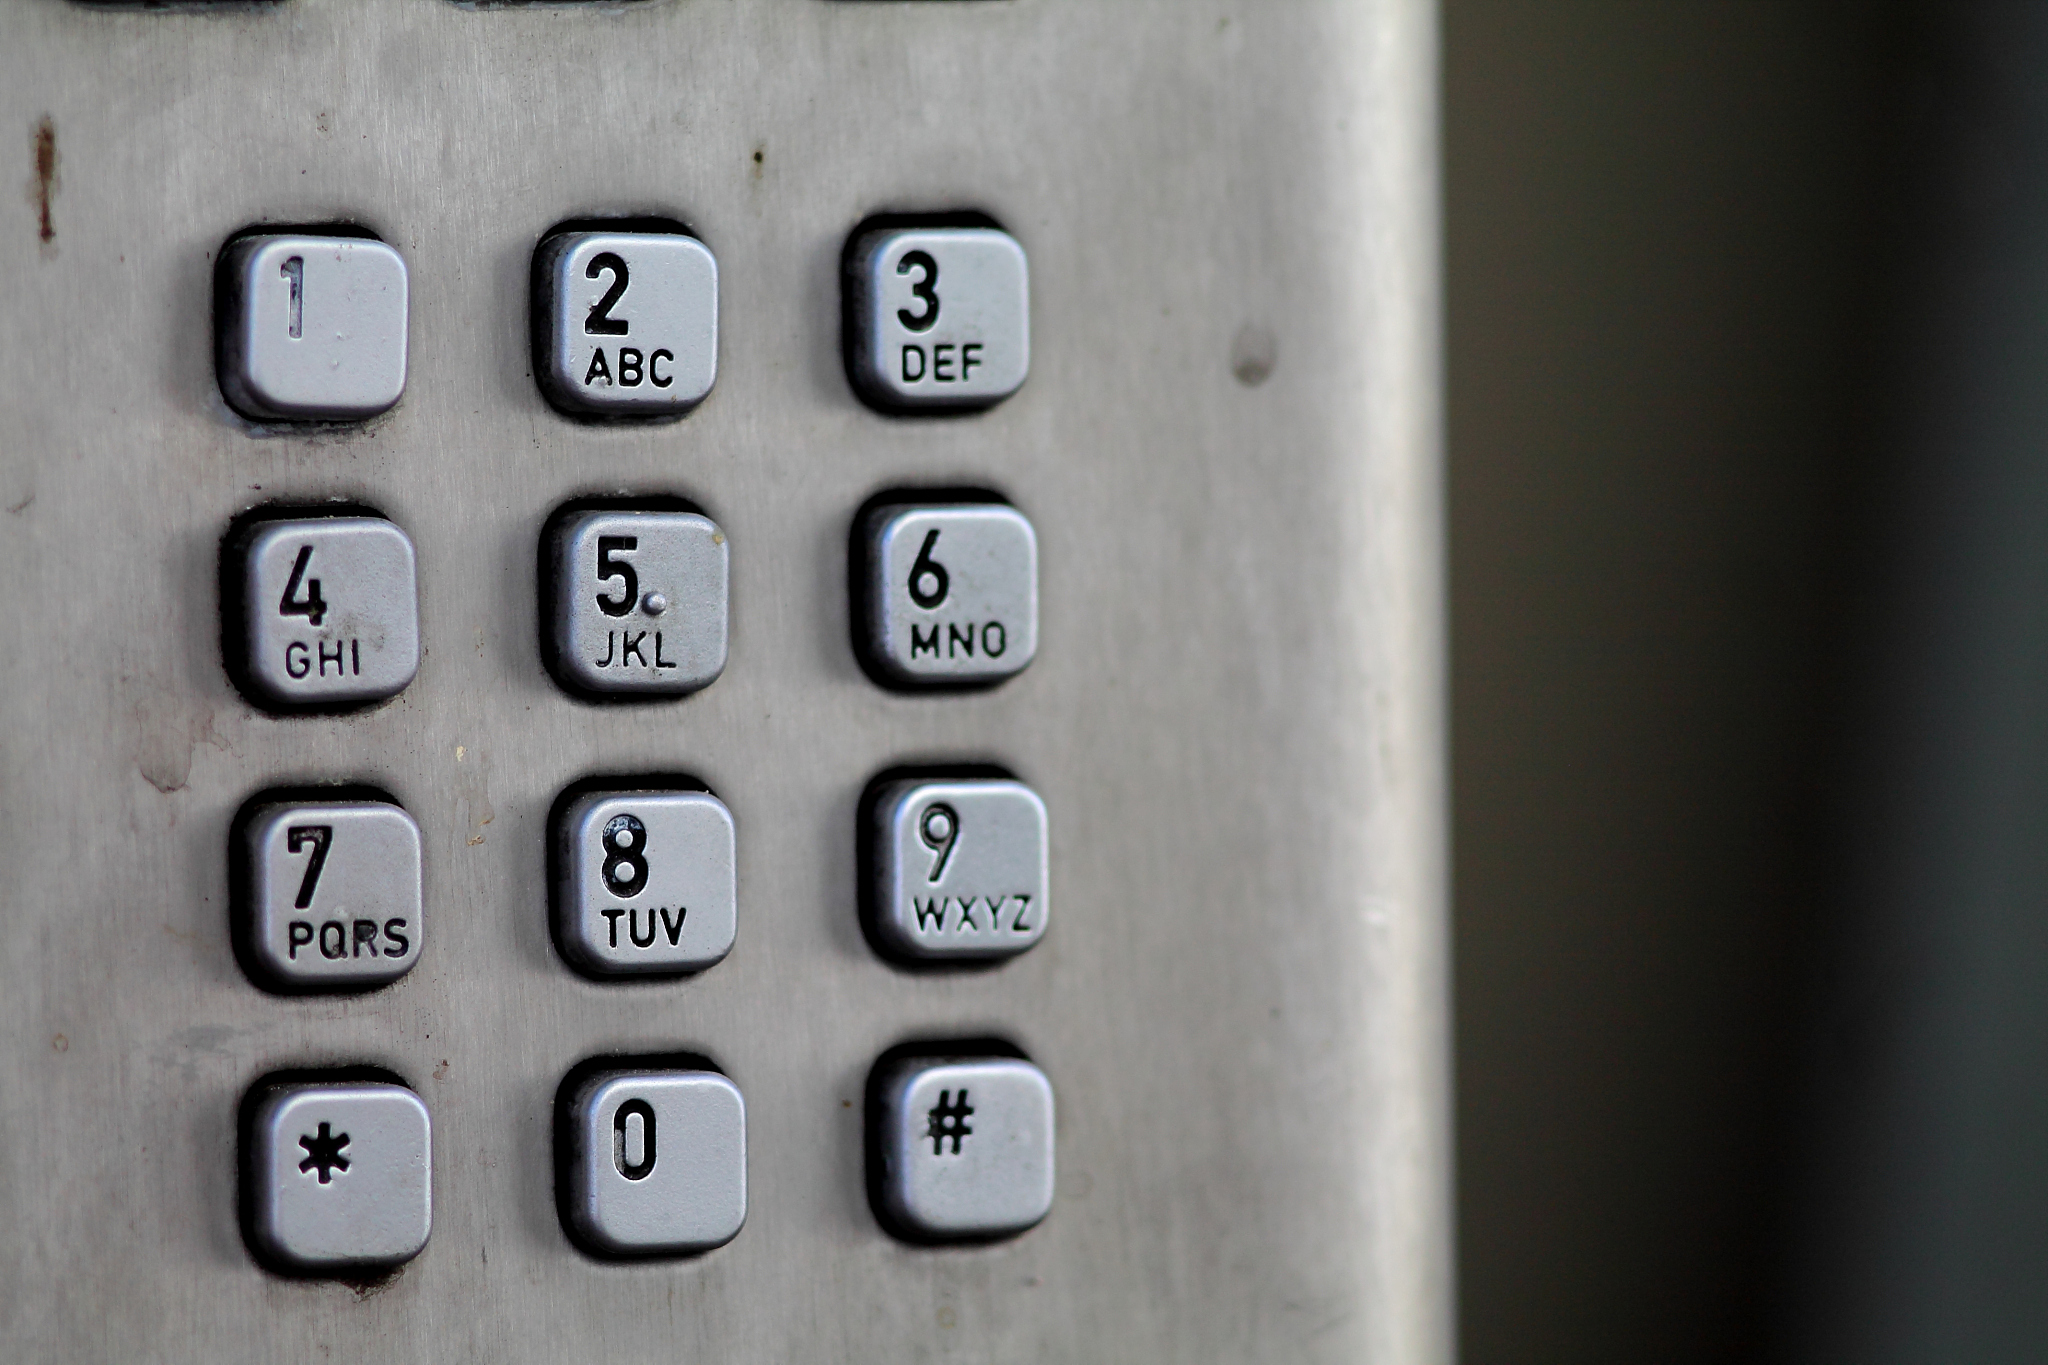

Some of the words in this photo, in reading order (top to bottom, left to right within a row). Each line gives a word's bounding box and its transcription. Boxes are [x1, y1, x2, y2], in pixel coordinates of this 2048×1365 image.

[279, 254, 305, 340] 1
[584, 251, 630, 336] 2
[896, 248, 941, 332] 3
[584, 346, 675, 388] ABC
[901, 342, 984, 383] DEF
[279, 544, 328, 627] 4
[595, 534, 639, 618] 5
[907, 528, 951, 610] 6
[285, 638, 360, 680] GHI
[595, 629, 677, 669] JKL
[910, 620, 1007, 659] MNO
[287, 824, 333, 910] 7
[601, 813, 649, 899] 8
[919, 800, 961, 882] 9
[288, 917, 410, 960] PQRS
[600, 906, 687, 949] TUV
[913, 893, 1032, 932] WXYZ
[925, 1088, 975, 1156] #
